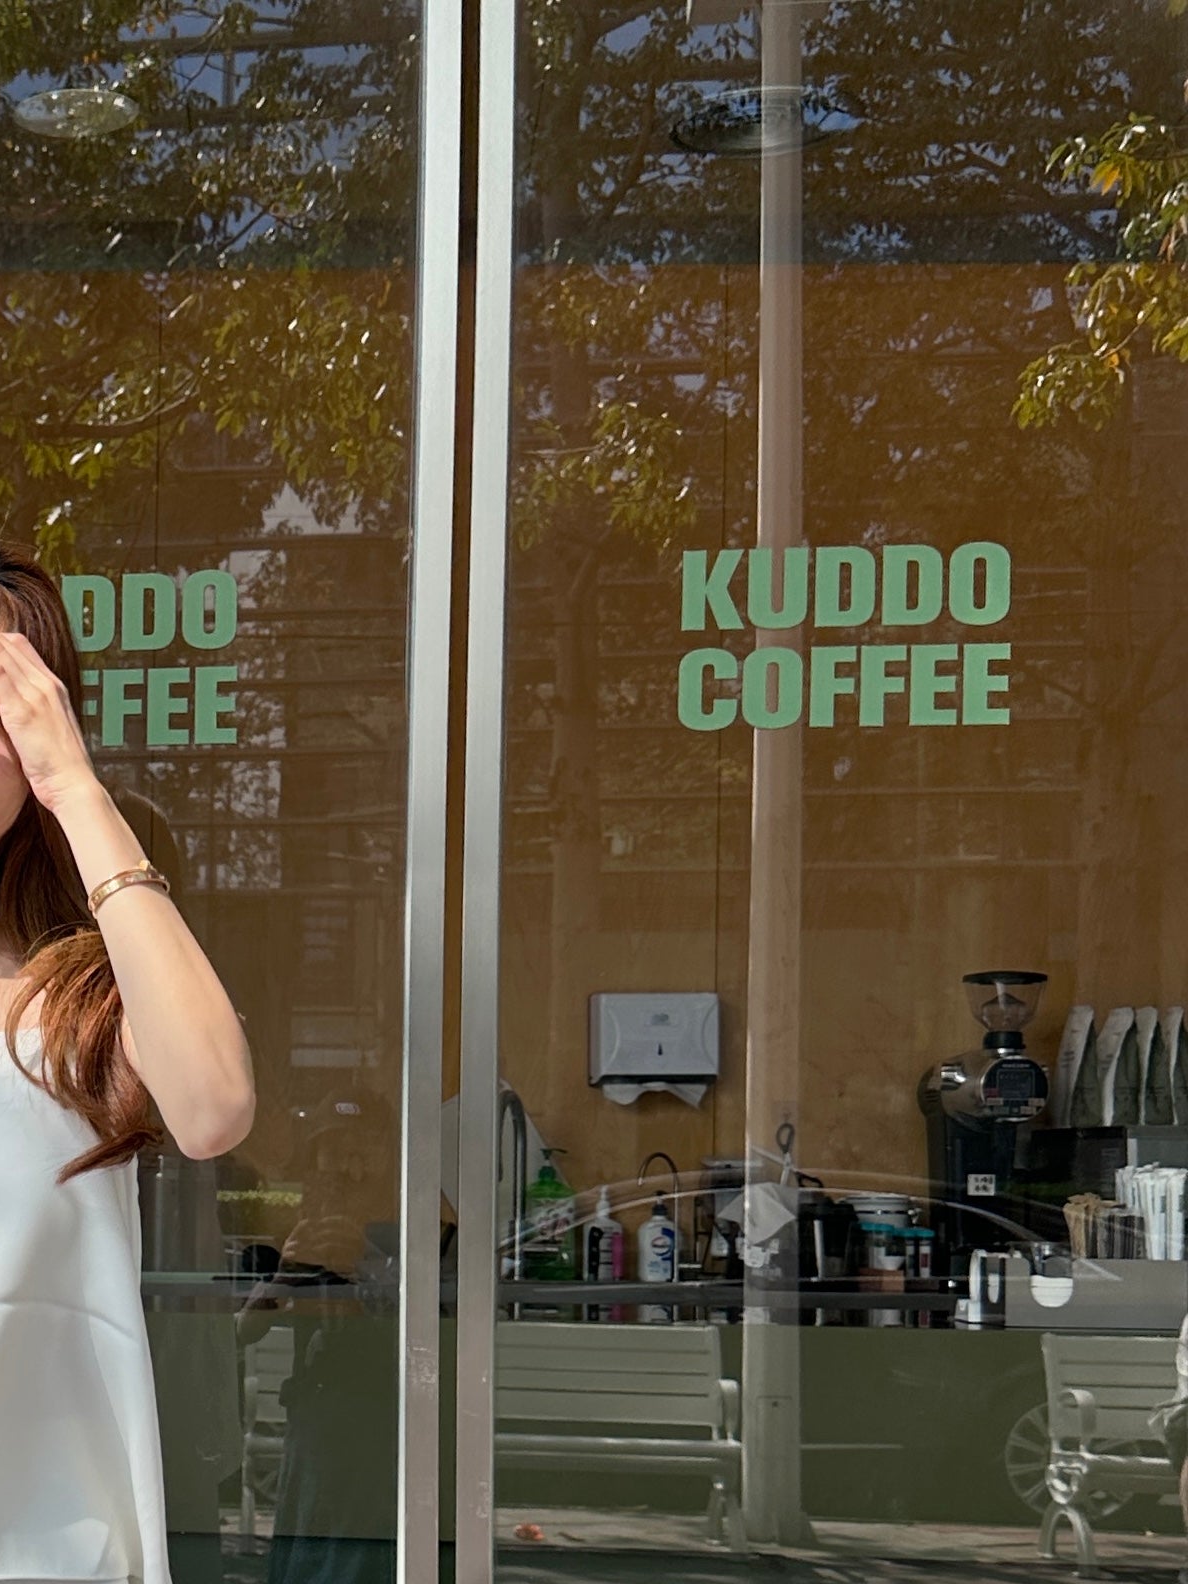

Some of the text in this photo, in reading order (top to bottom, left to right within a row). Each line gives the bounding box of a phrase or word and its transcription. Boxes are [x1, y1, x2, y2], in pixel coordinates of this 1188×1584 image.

[62, 569, 238, 652] DDO
[681, 541, 1011, 632] KUDDO
[82, 666, 238, 746] FEE
[677, 643, 1011, 731] COFFEE
